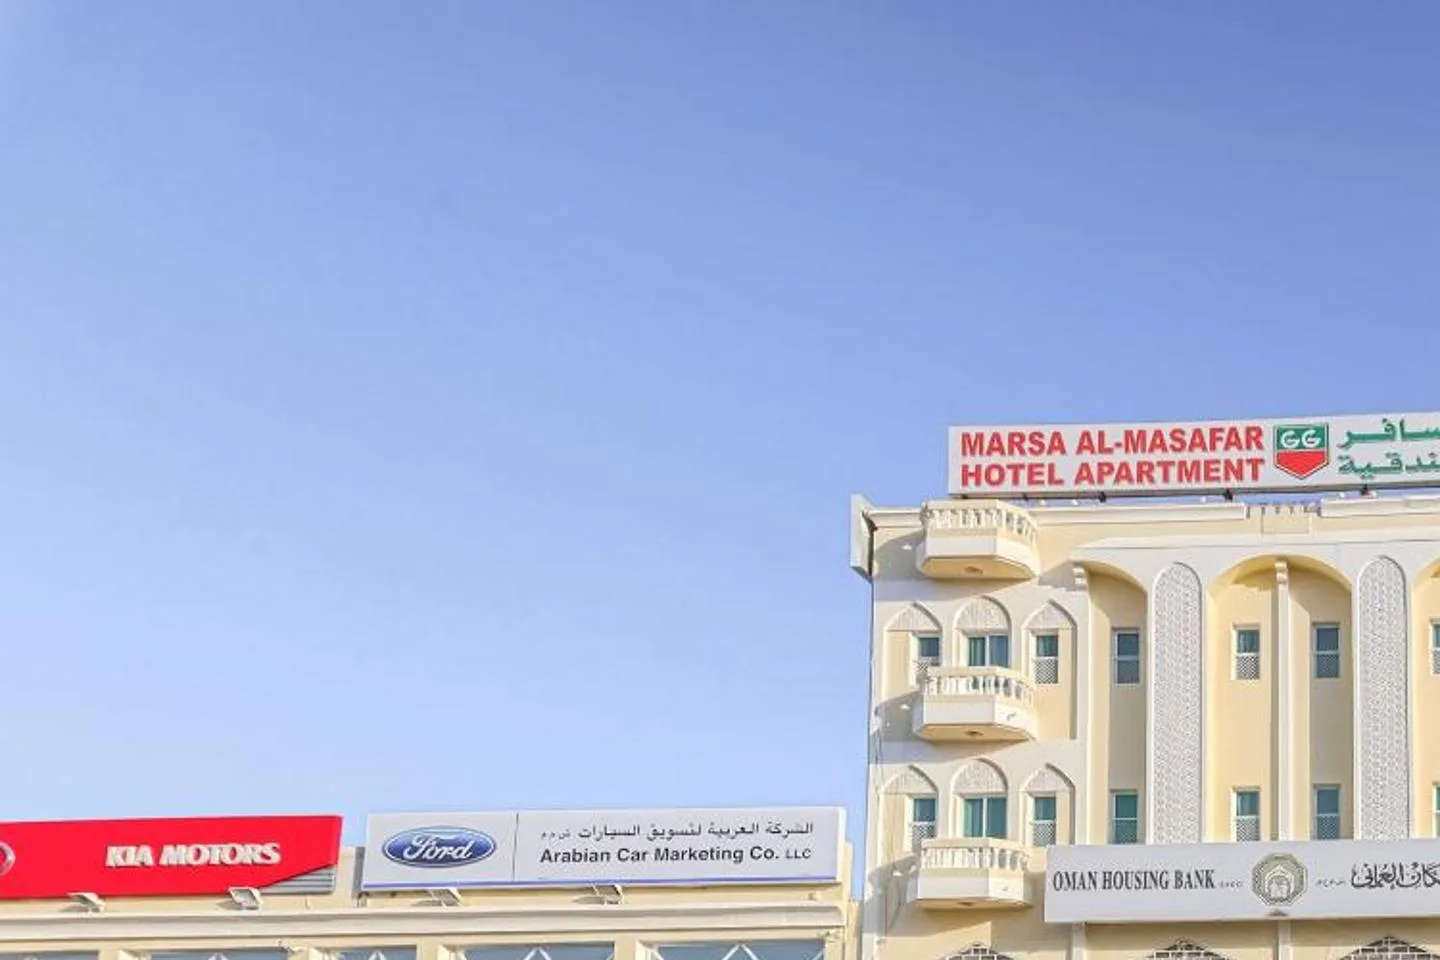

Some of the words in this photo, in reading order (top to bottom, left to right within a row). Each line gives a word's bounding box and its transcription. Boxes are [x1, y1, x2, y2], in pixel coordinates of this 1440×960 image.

[960, 431, 1066, 457] MARSA
[1075, 425, 1264, 455] AL-MASAFAR
[1280, 426, 1321, 449] GG
[960, 462, 1065, 487] HOTEL
[1073, 457, 1265, 485] APARTMENT
[578, 823, 641, 842] السيارات
[646, 823, 702, 841] لتسويق
[707, 822, 760, 839] العربية
[764, 822, 814, 836] الشركة
[105, 844, 154, 868] KIA
[159, 842, 282, 867] MOTORS
[403, 834, 476, 860] Ford
[539, 848, 611, 863] Arabian
[617, 848, 649, 863] Car
[654, 846, 744, 865] Marketing
[749, 846, 780, 861] Co.
[785, 849, 812, 860] LLC
[1053, 871, 1098, 892] OMAN
[1102, 869, 1169, 890] HOUSING
[1173, 868, 1216, 890] BANK
